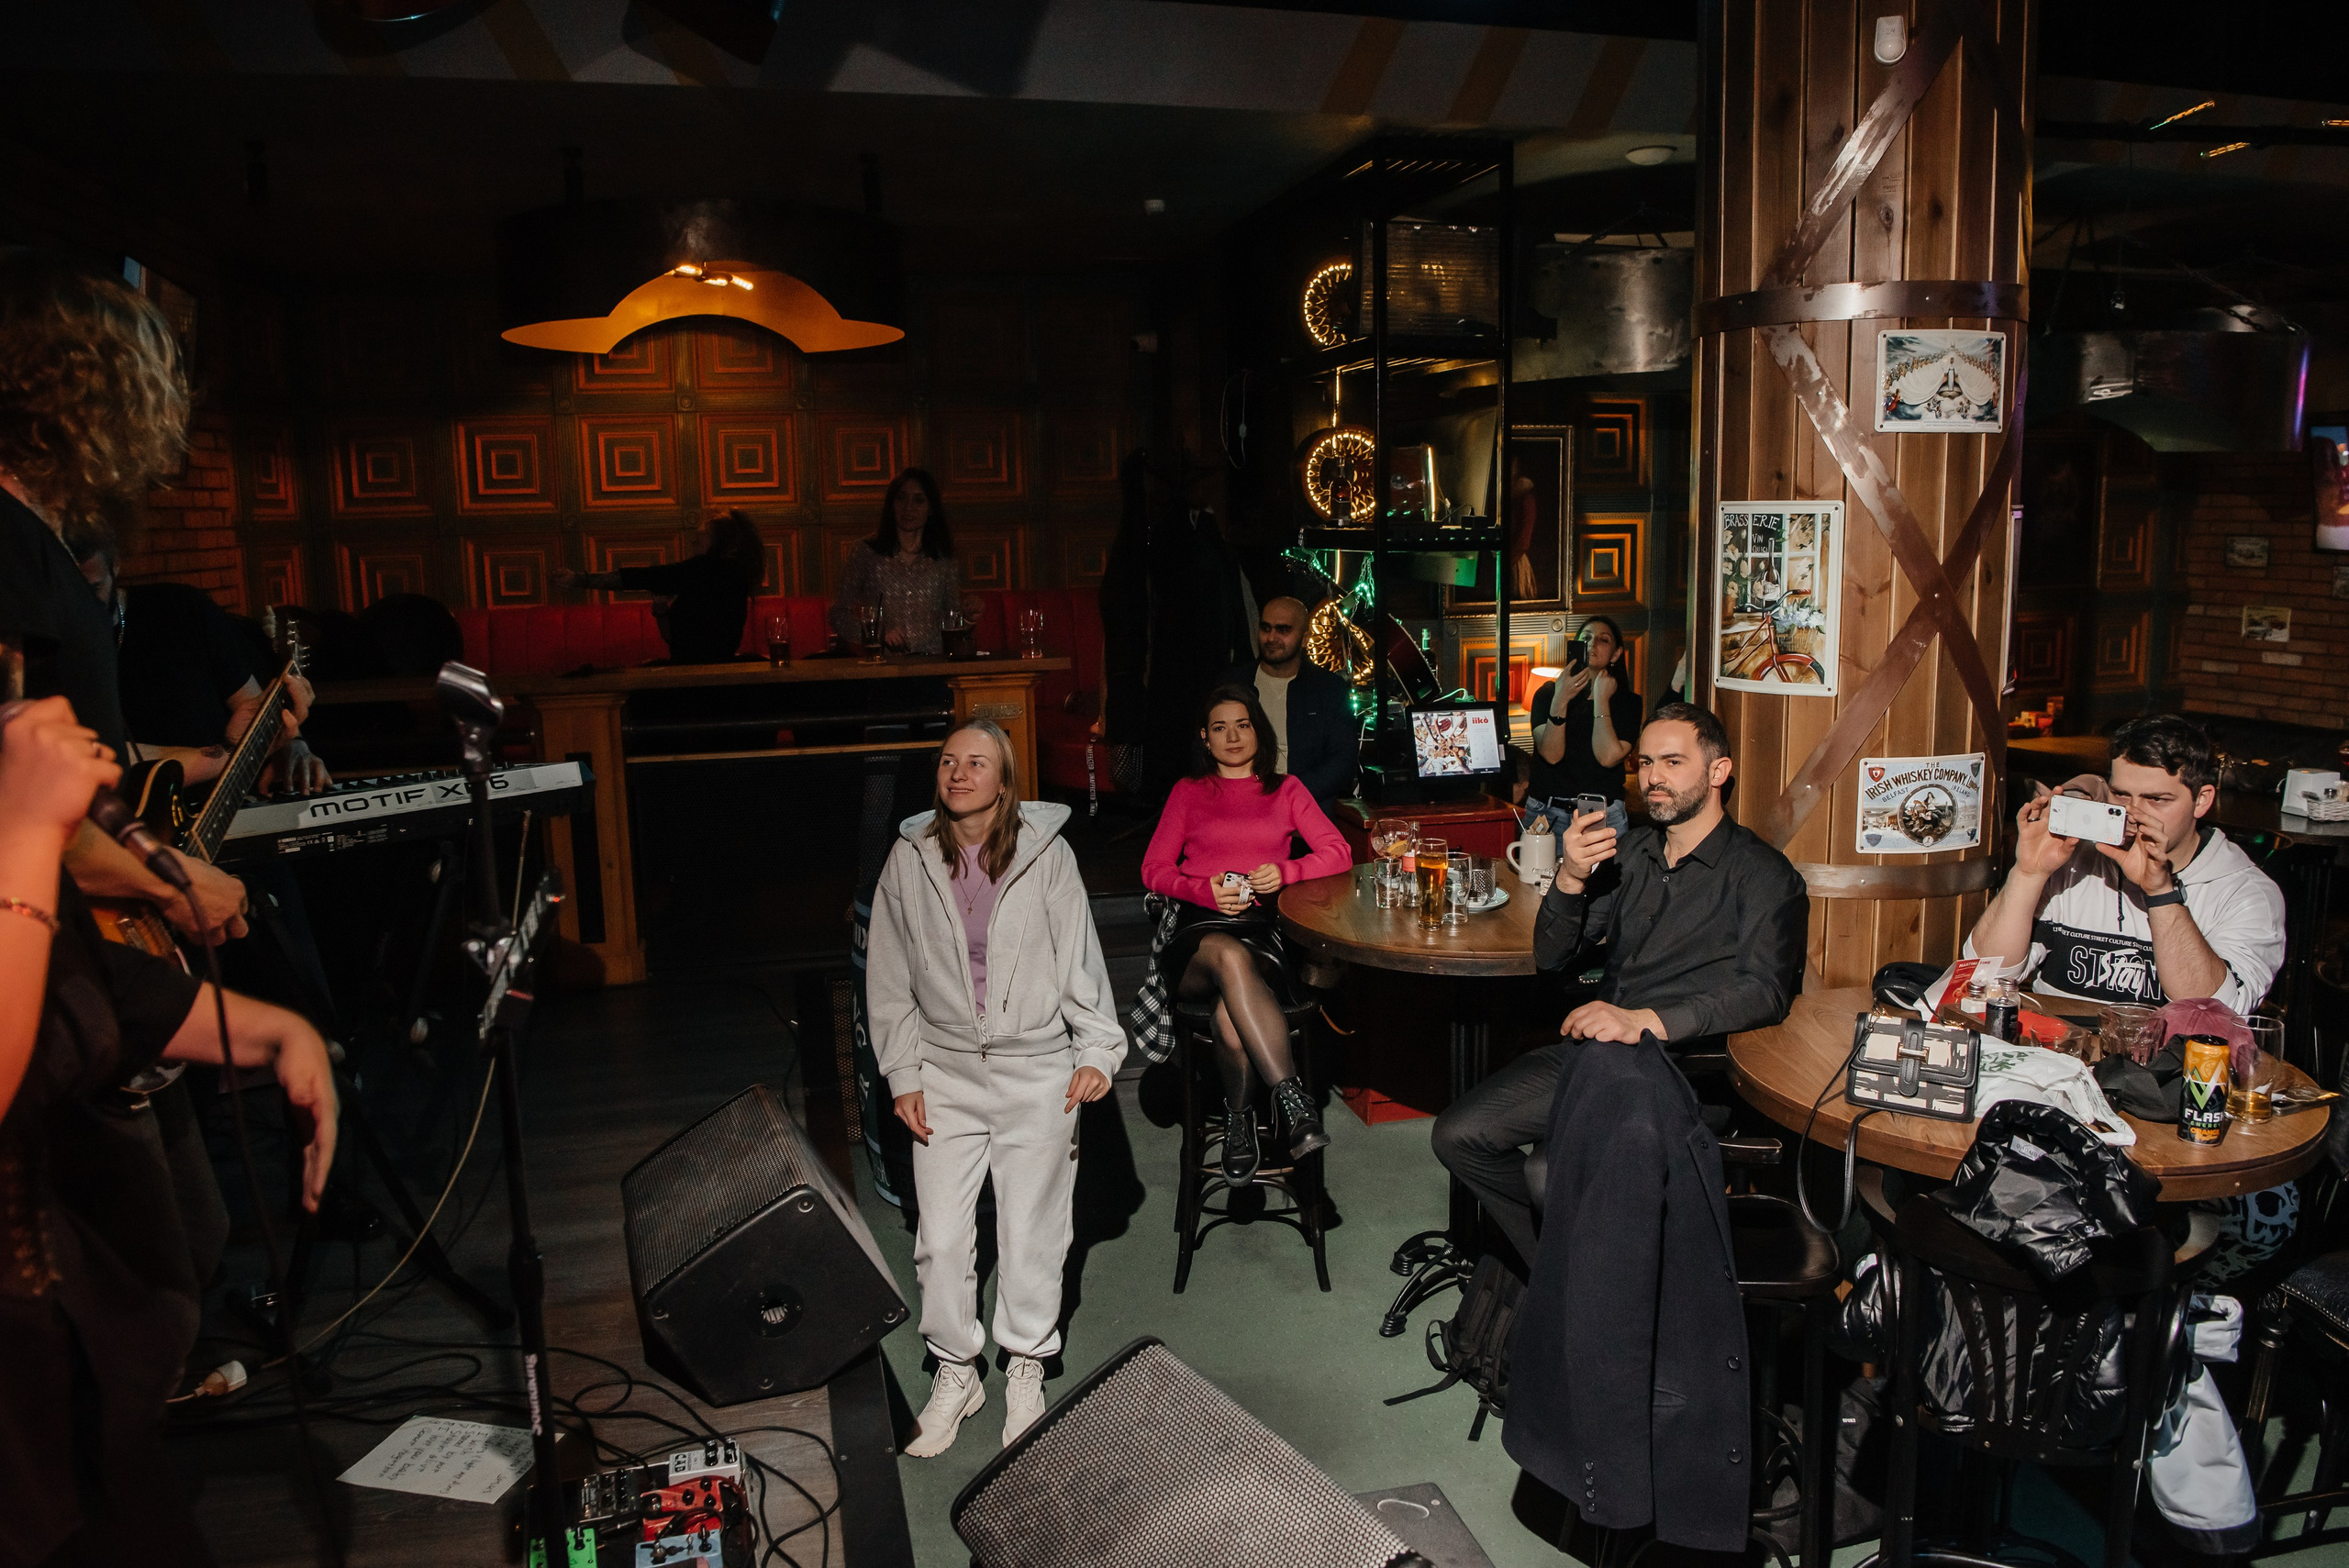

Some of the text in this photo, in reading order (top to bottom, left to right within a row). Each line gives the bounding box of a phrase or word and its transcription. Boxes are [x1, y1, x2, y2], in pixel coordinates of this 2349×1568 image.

[1753, 533, 1764, 543] VIN
[1865, 779, 1893, 800] IRISH
[1891, 769, 1933, 787] WHISKEY
[1951, 785, 1971, 797] IRELAND
[1882, 787, 1909, 803] BELFAST
[309, 788, 427, 817] MOTIF
[2108, 938, 2132, 947] CULTURE
